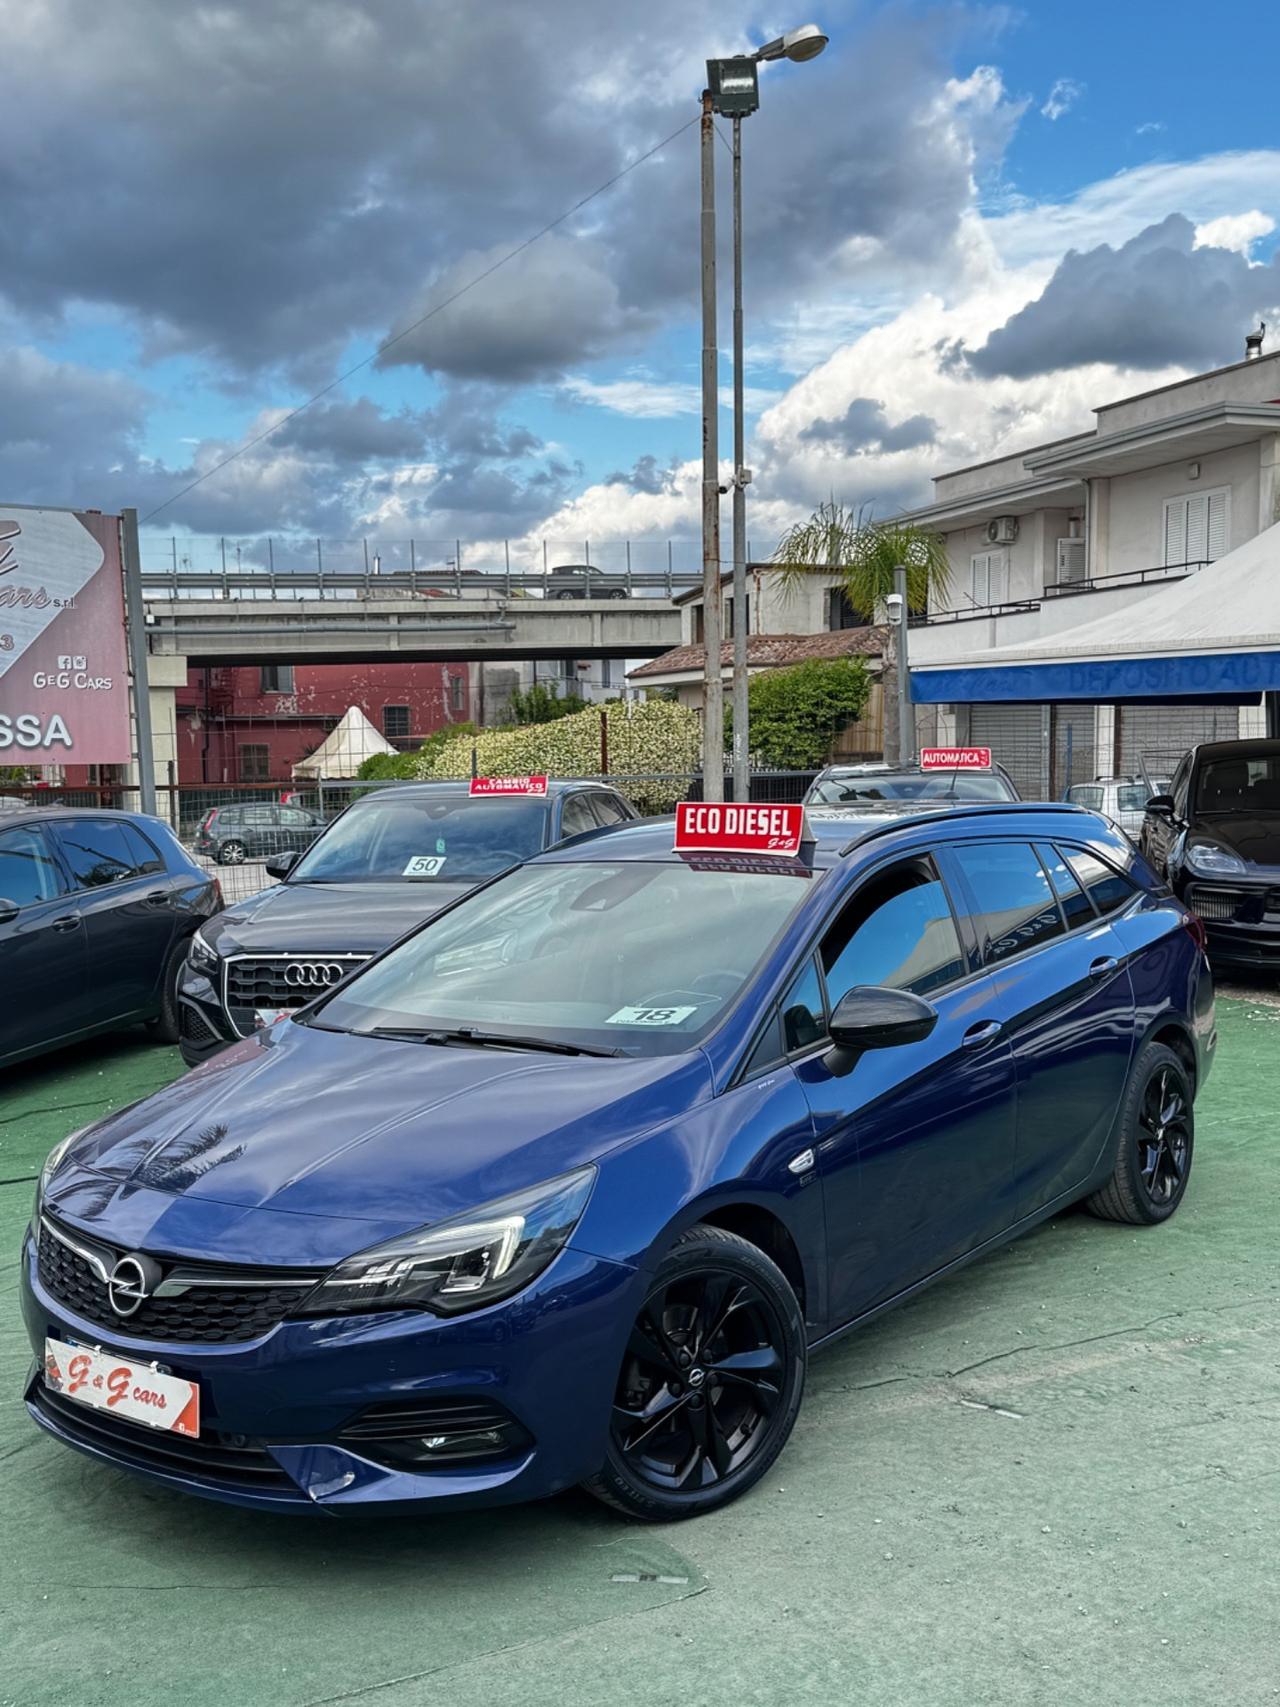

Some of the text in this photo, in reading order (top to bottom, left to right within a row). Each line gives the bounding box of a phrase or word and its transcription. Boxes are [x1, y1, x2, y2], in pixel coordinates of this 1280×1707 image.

[923, 752, 980, 764] AUTOMATICA
[474, 782, 544, 791] AUTOMATICO
[488, 778, 531, 786] CAMBIO
[684, 807, 793, 837] ECO DIESEL
[412, 858, 439, 872] 50
[633, 1009, 678, 1021] 18
[132, 1386, 168, 1409] cars
